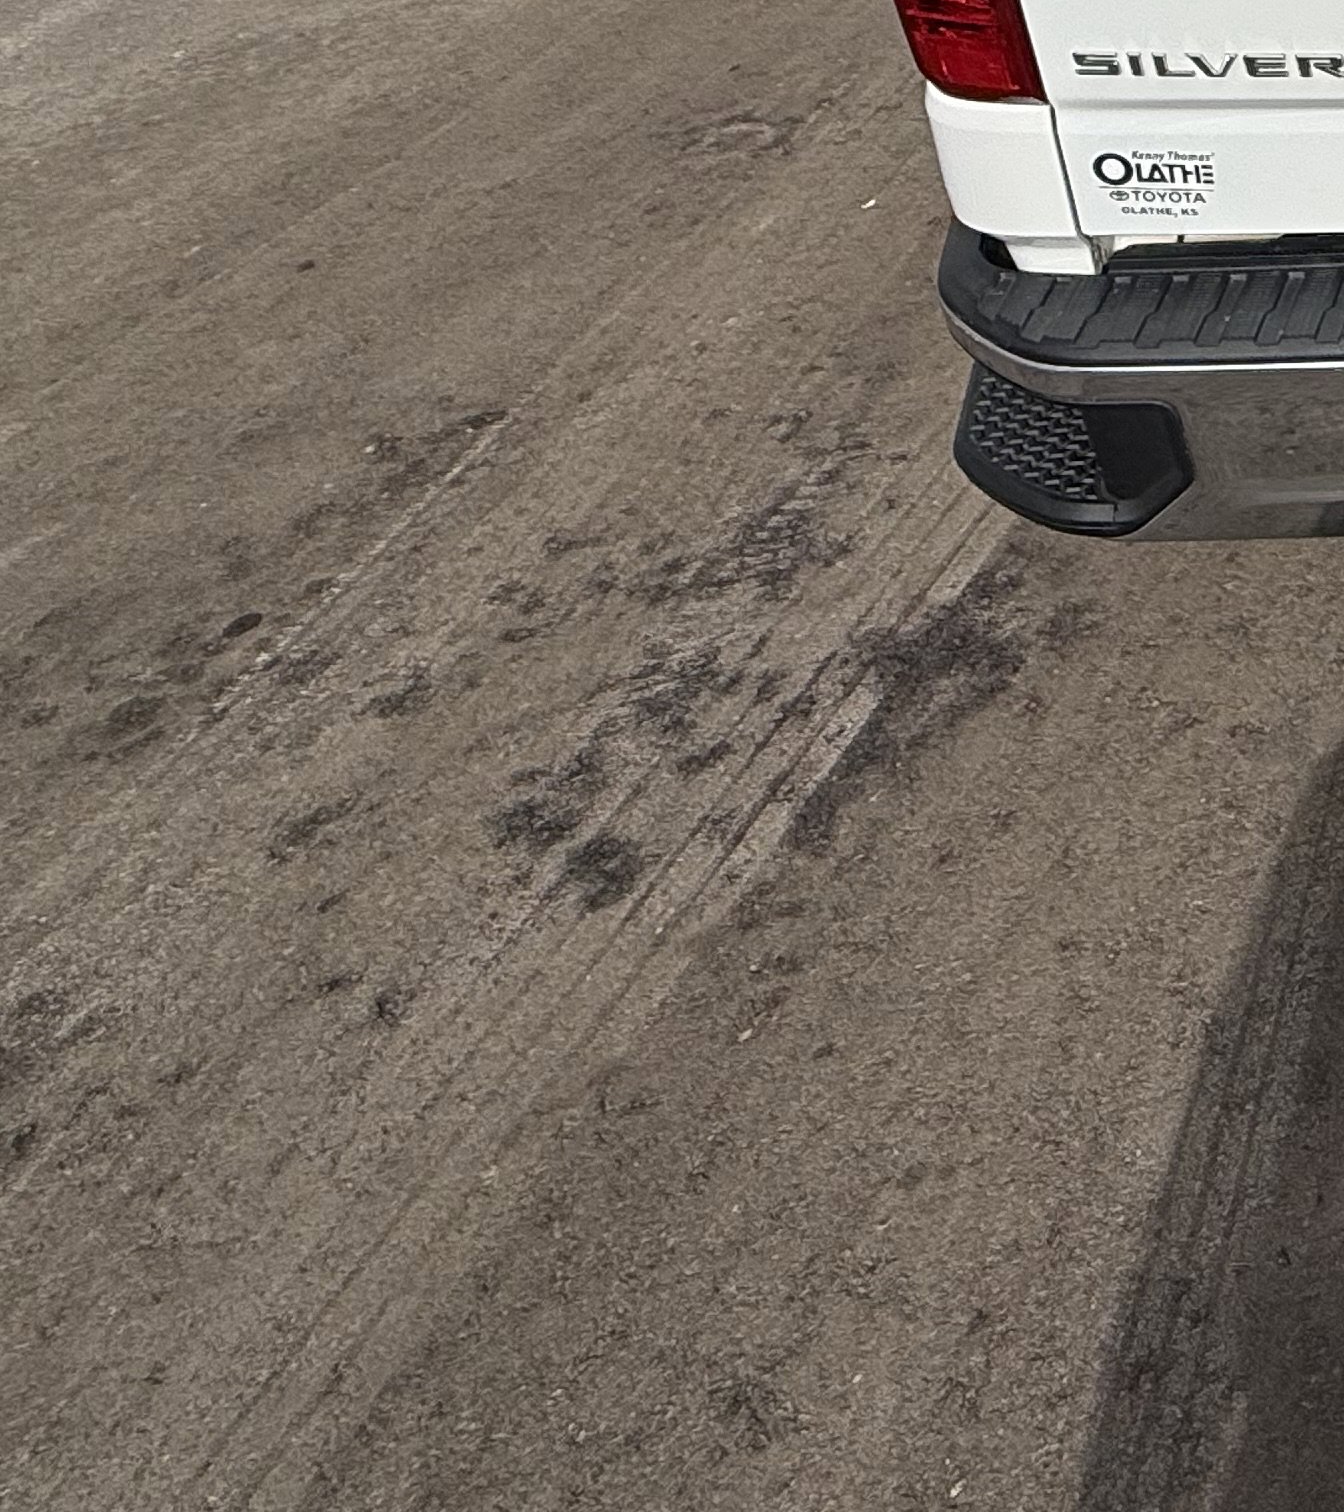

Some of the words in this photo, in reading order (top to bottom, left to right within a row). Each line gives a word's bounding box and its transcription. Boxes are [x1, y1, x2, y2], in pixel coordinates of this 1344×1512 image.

[1092, 153, 1215, 185] OLATHE
[1131, 190, 1206, 203] TOYOTA
[1181, 207, 1199, 216] KS
